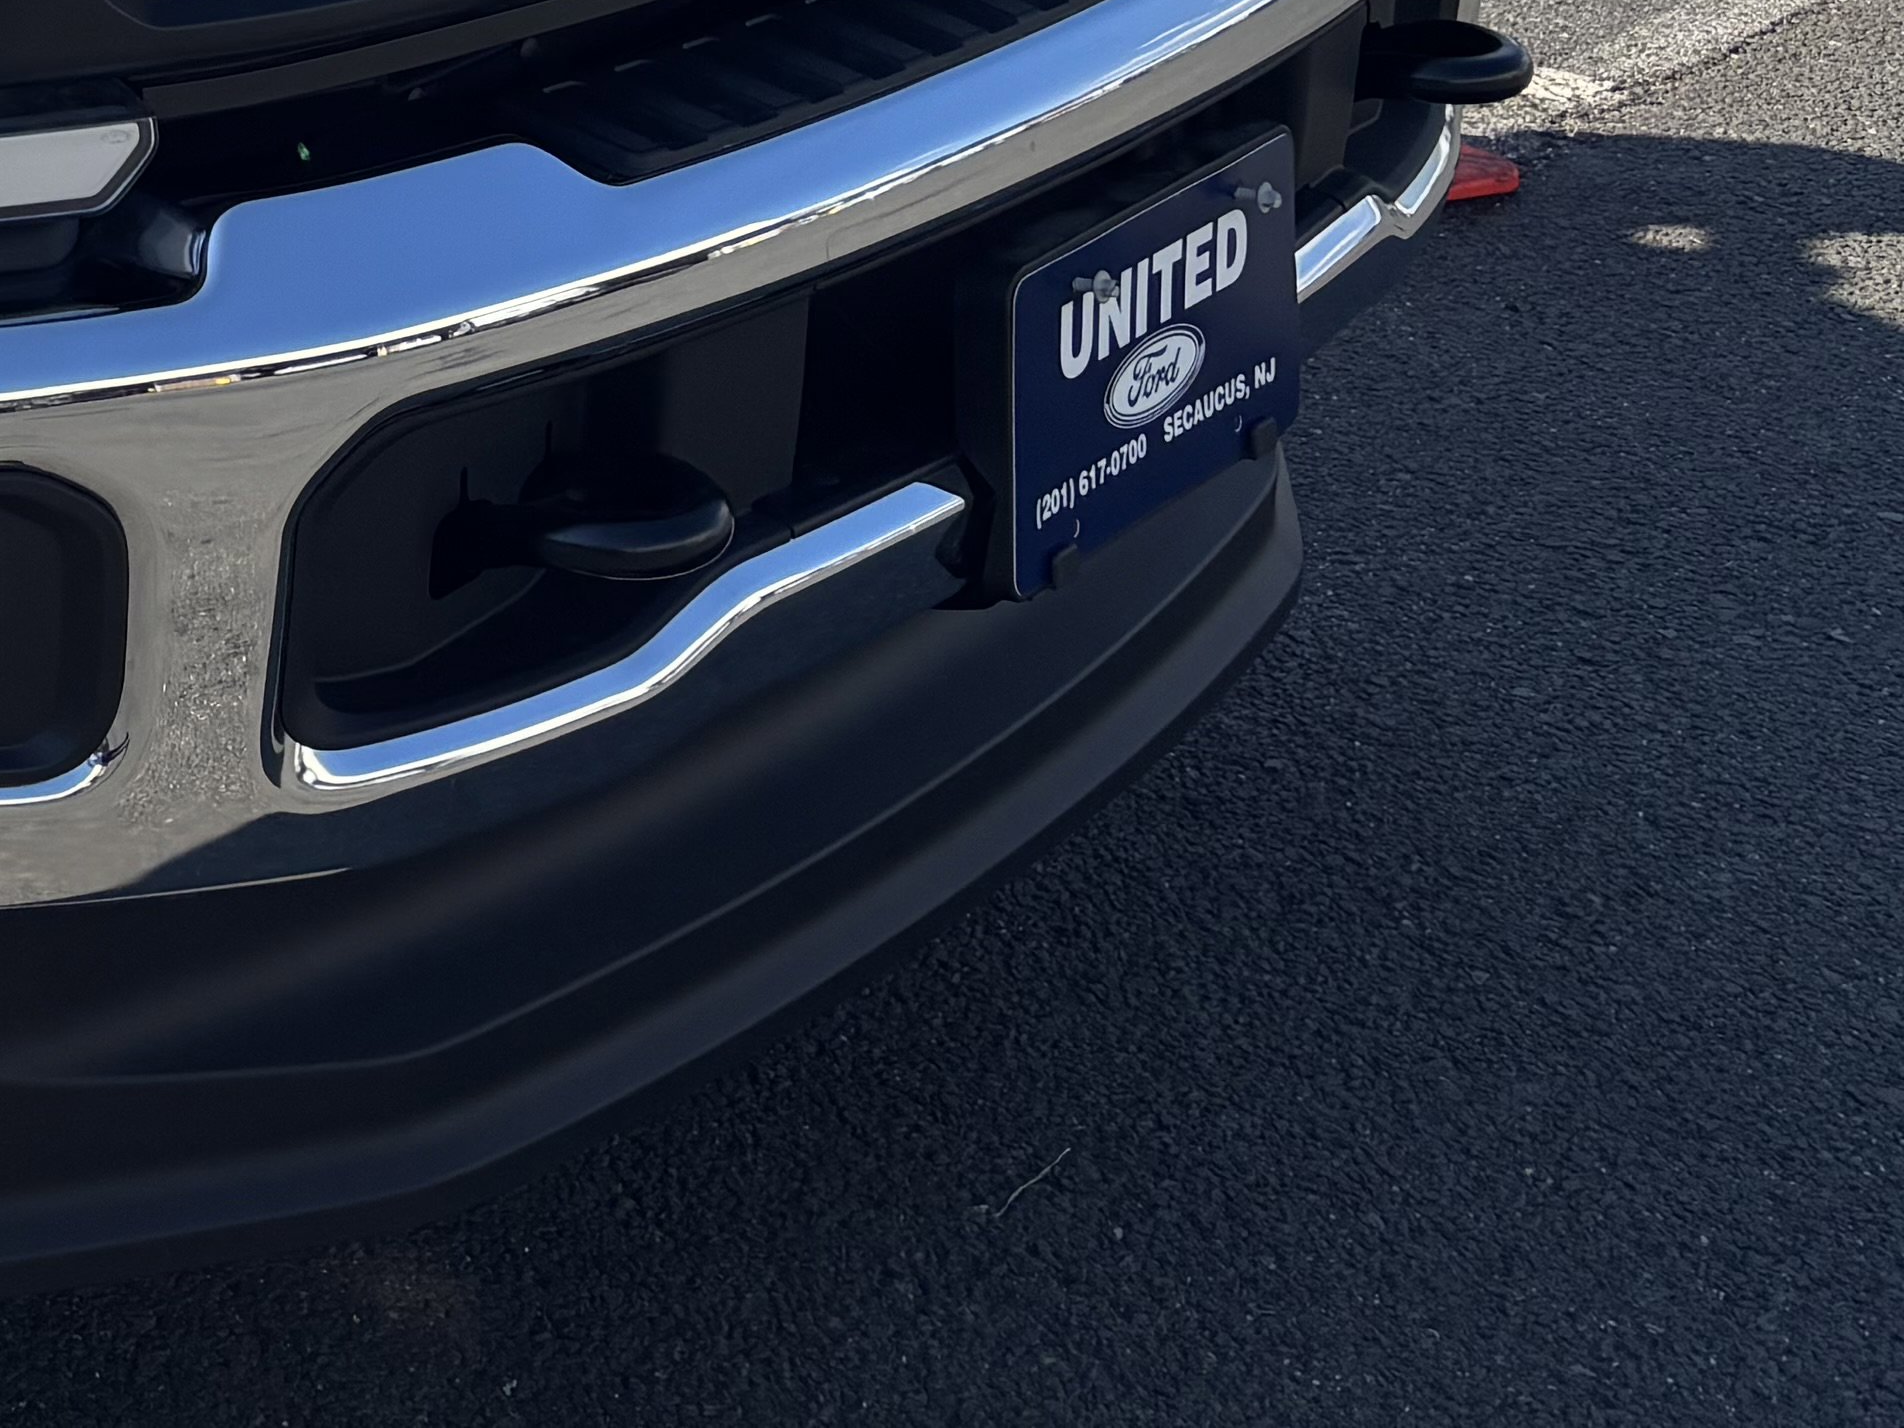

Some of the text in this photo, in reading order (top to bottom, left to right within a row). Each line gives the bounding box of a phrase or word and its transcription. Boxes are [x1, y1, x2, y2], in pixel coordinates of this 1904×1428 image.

[1059, 207, 1248, 380] UNITED
[1127, 344, 1182, 408] Ford
[1036, 356, 1277, 530] (201) 617-0700 SECAUCUS, NJ
